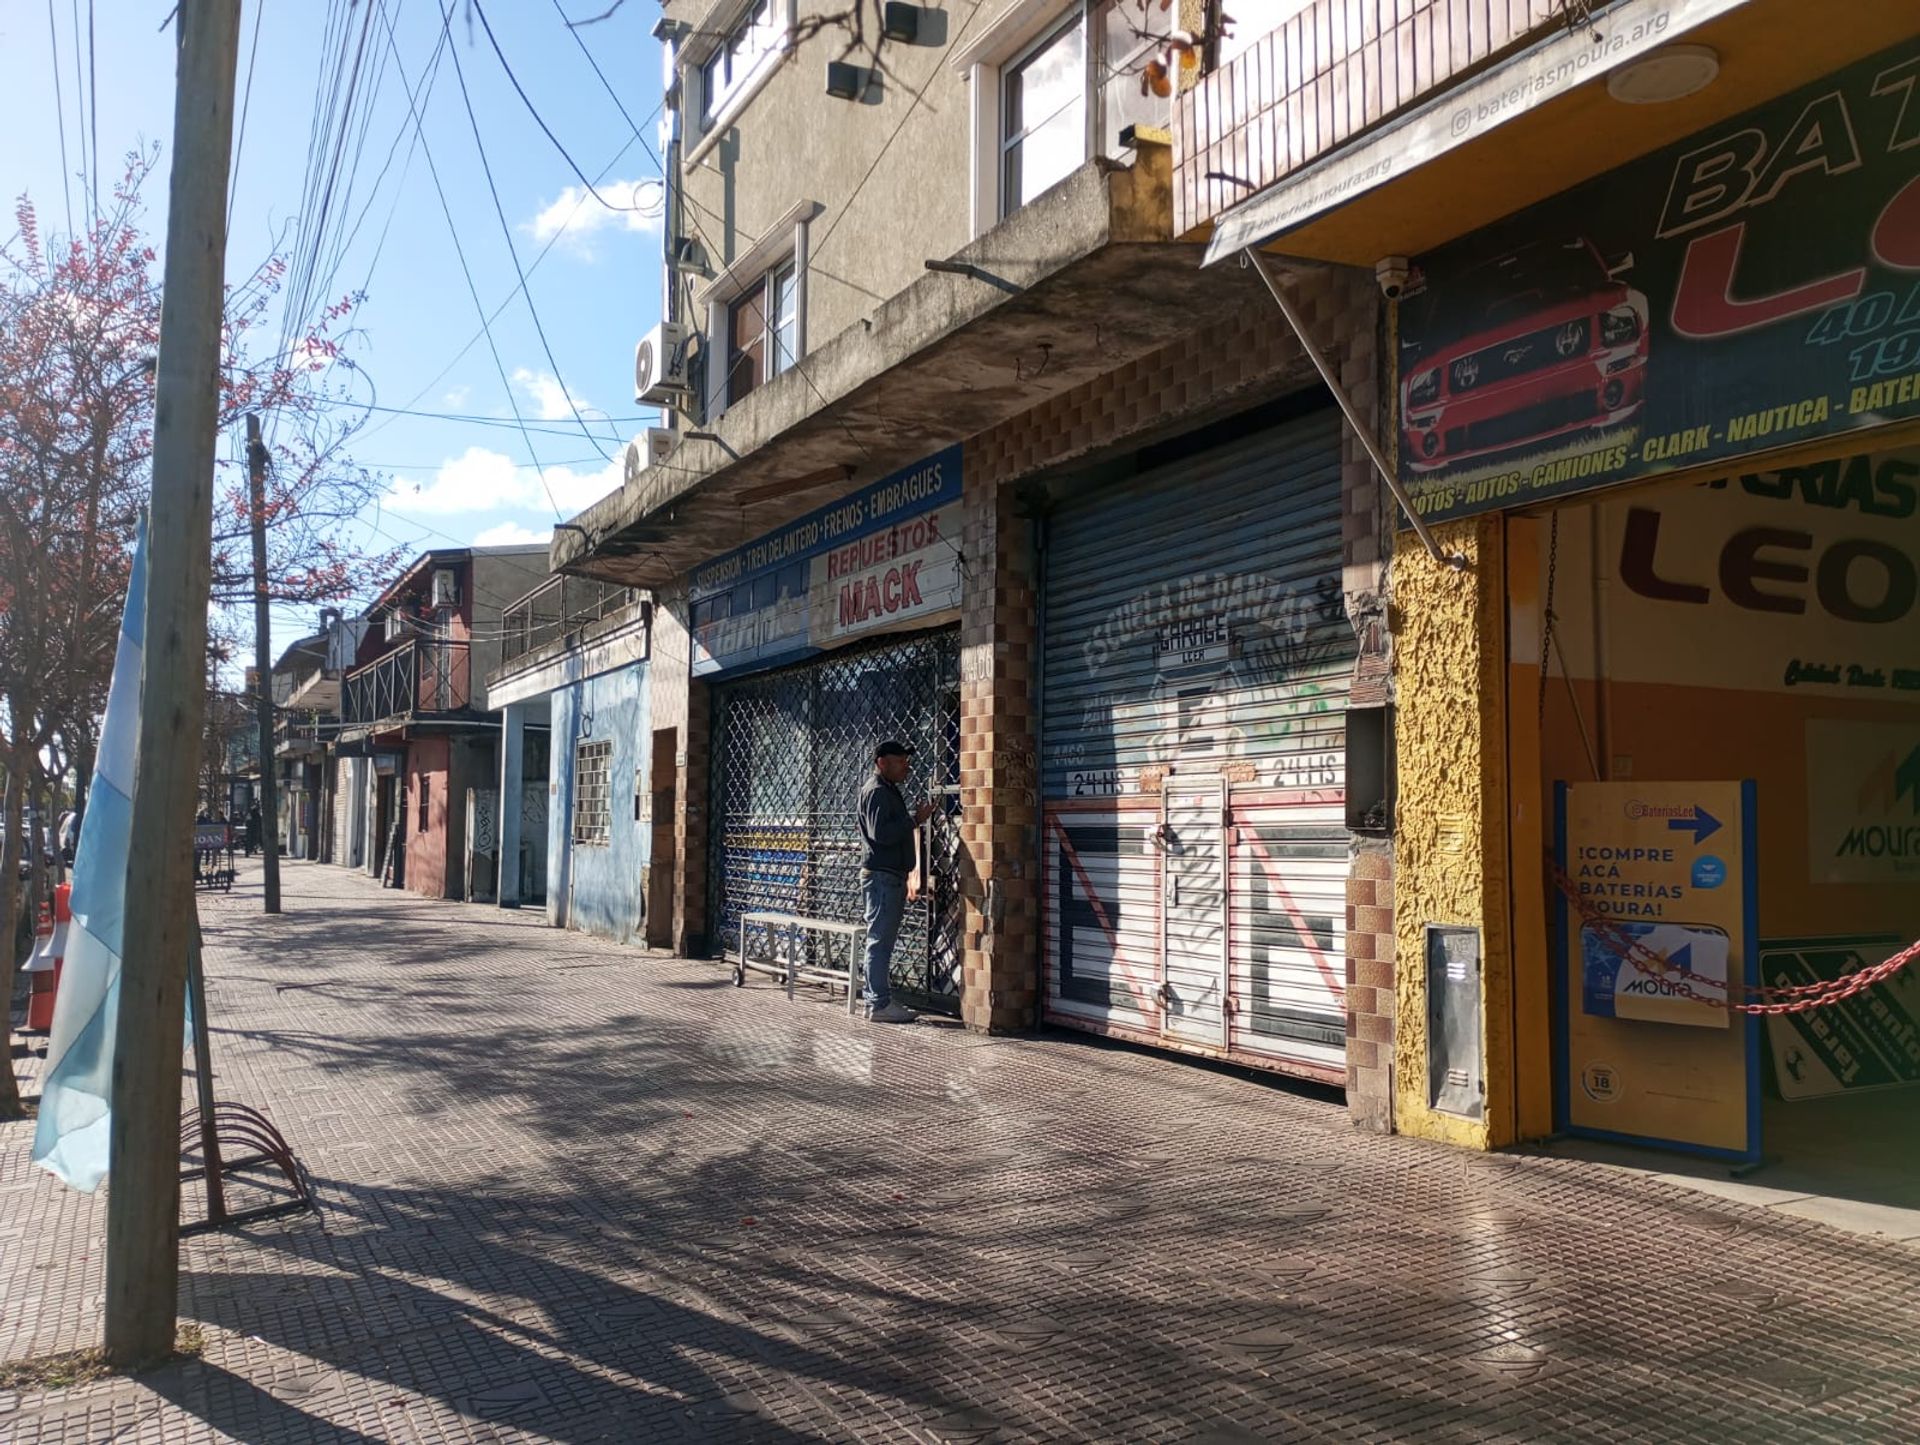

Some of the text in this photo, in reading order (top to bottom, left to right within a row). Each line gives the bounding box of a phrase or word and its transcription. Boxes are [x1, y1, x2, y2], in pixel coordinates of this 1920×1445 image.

[1476, 10, 1671, 123] bateriasmoura.arg
[1850, 329, 1920, 382] 19
[1466, 471, 1520, 504] AUTOS
[1531, 445, 1628, 489] CAMIONES
[1642, 425, 1711, 462] CLARK
[1726, 396, 1829, 442] NAUTICA
[747, 541, 768, 573] TREN
[768, 522, 819, 565] DELANTERO
[824, 503, 863, 541] FRENOS
[870, 463, 943, 518] EMBRAGUES
[827, 515, 939, 583] REPUESTOS
[1619, 506, 1918, 624] LEO
[839, 560, 923, 627] MACK
[1158, 614, 1227, 651] GARAGE
[1073, 771, 1096, 796] 24
[1273, 758, 1300, 788] 24
[1578, 846, 1674, 862] !COMPRE
[1578, 861, 1621, 878] ACÁ
[1579, 879, 1683, 899] BATERÍAS
[1593, 1075, 1610, 1089] 18
